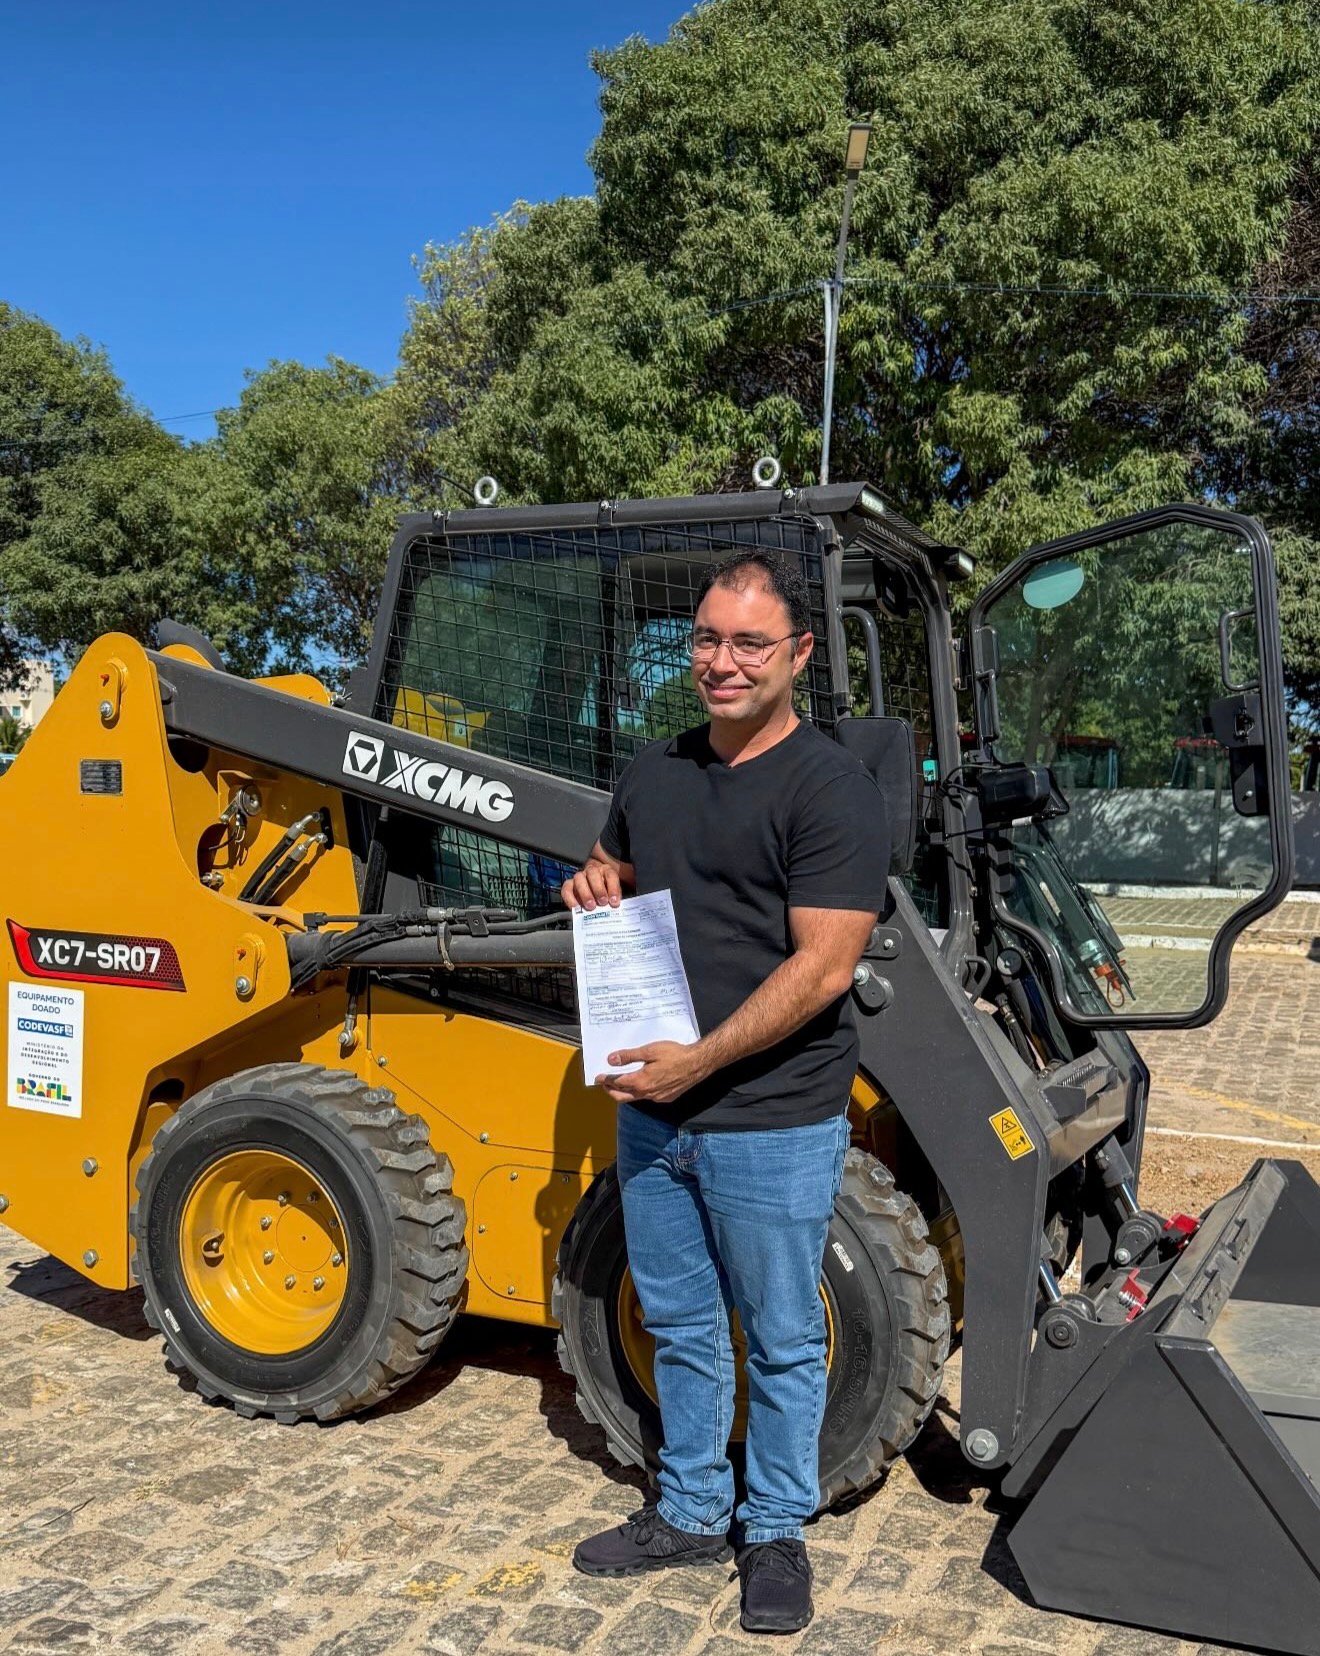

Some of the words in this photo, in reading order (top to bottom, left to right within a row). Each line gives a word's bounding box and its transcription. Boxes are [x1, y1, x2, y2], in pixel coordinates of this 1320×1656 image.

[379, 750, 514, 822] XCMG
[37, 937, 161, 973] XC7-SR07
[17, 991, 75, 1005] EQUIPAMENTO
[32, 1003, 61, 1014] DOADO
[18, 1020, 65, 1034] CODEVASF
[16, 1077, 72, 1101] BRASIL
